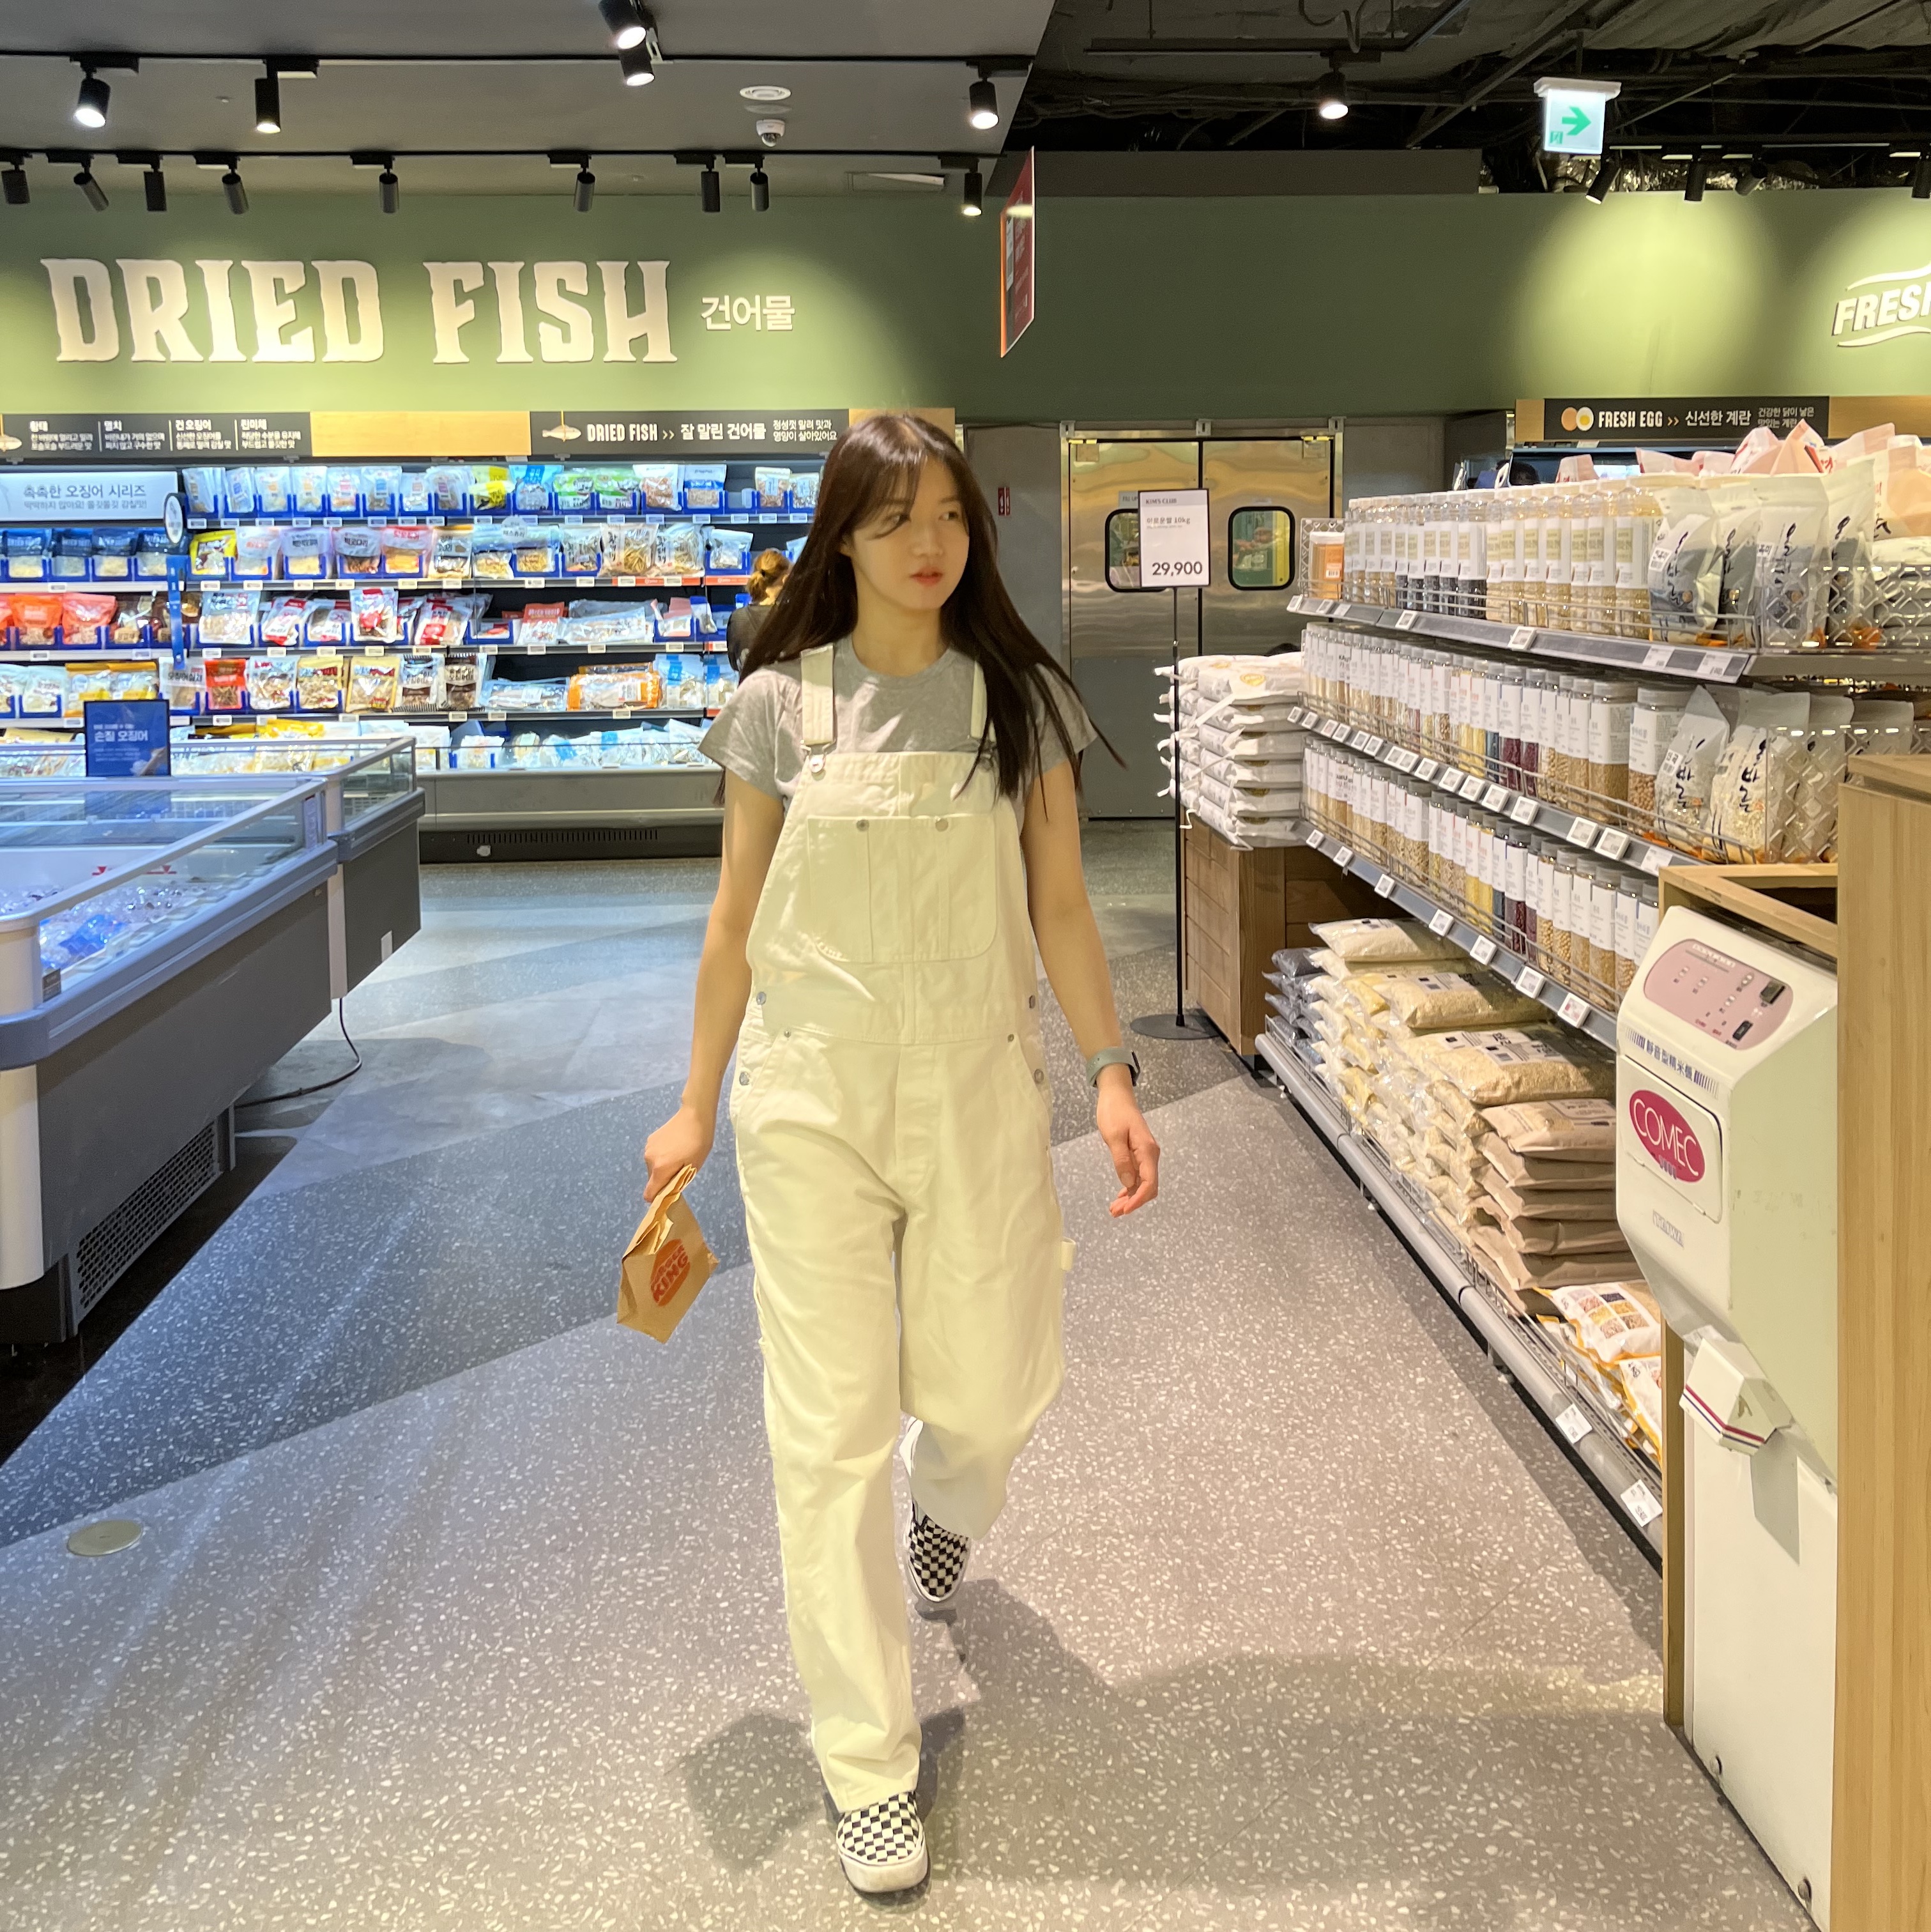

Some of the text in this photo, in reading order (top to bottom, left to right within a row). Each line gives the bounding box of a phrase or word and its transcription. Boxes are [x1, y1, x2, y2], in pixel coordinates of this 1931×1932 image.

[40, 258, 677, 364] DRIED FISH
[701, 295, 795, 331] 건어물
[1598, 411, 1663, 428] FRESH EGG
[1685, 410, 1752, 427] 신선한 계란
[1757, 408, 1780, 418] 건강한
[587, 423, 658, 442] DRIED FISH
[681, 423, 767, 440] 잘 말린 건어물
[773, 420, 797, 431] 정성껏
[816, 419, 832, 430] 맛과
[798, 431, 837, 441] 살아있어요
[24, 484, 146, 499] 촉촉한 오징어 시리즈
[1152, 561, 1203, 577] 29,900
[118, 730, 148, 742] 오징어
[1633, 1098, 1699, 1177] COMEC
[653, 1252, 689, 1303] KING
